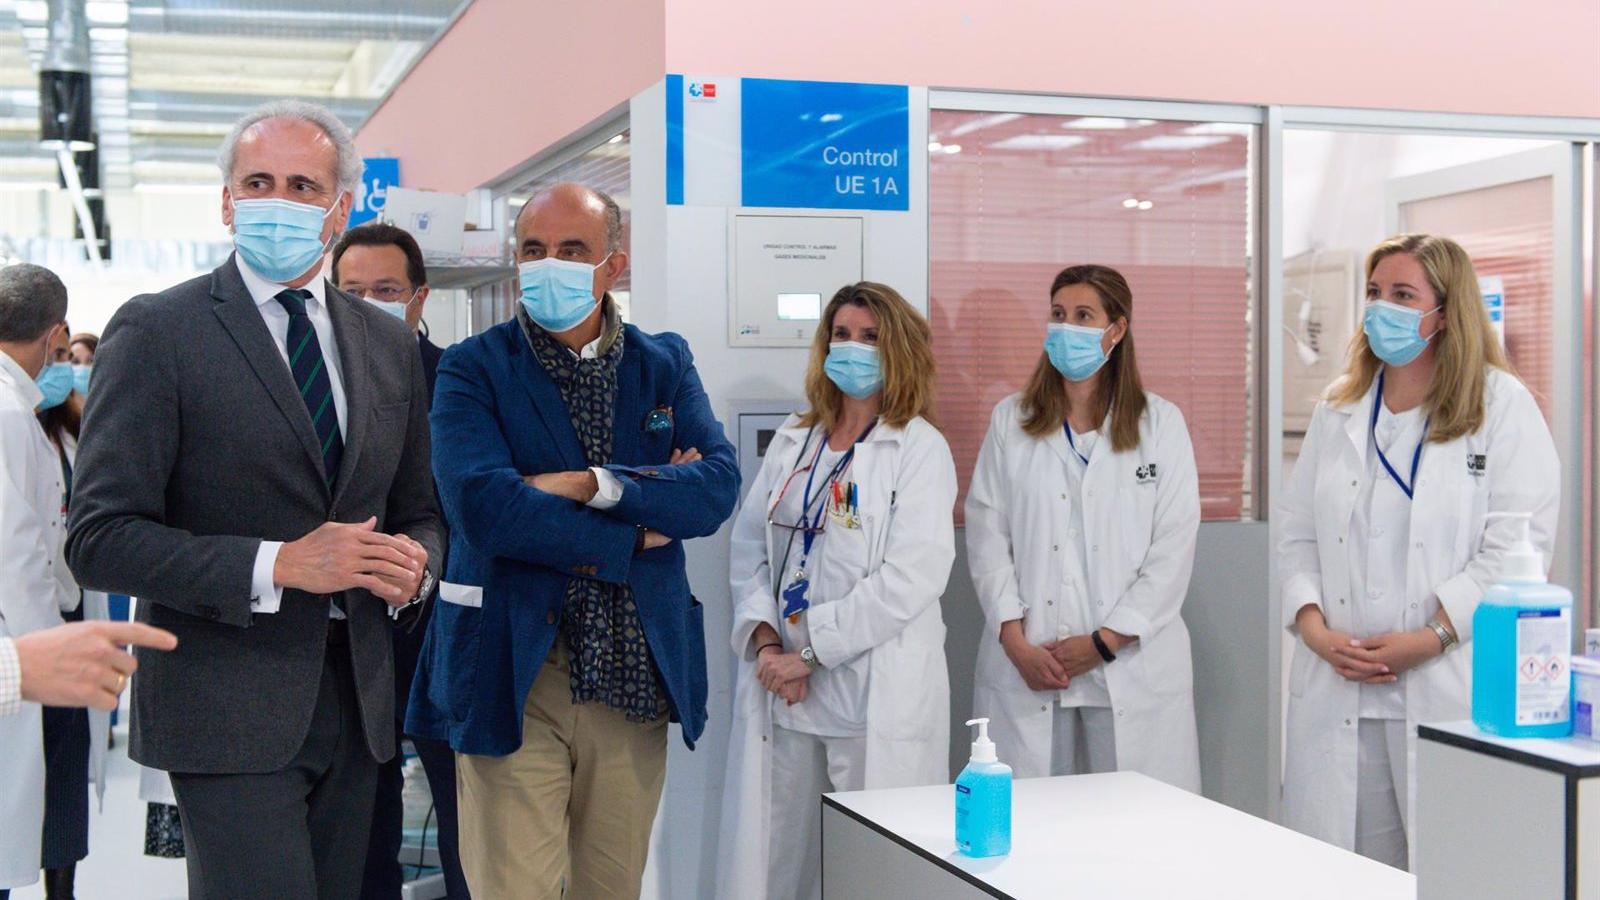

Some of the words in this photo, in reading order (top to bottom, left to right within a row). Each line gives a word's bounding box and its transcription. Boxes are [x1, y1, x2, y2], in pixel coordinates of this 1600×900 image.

[823, 146, 898, 167] Control
[836, 175, 865, 194] UE
[872, 176, 899, 195] 1A
